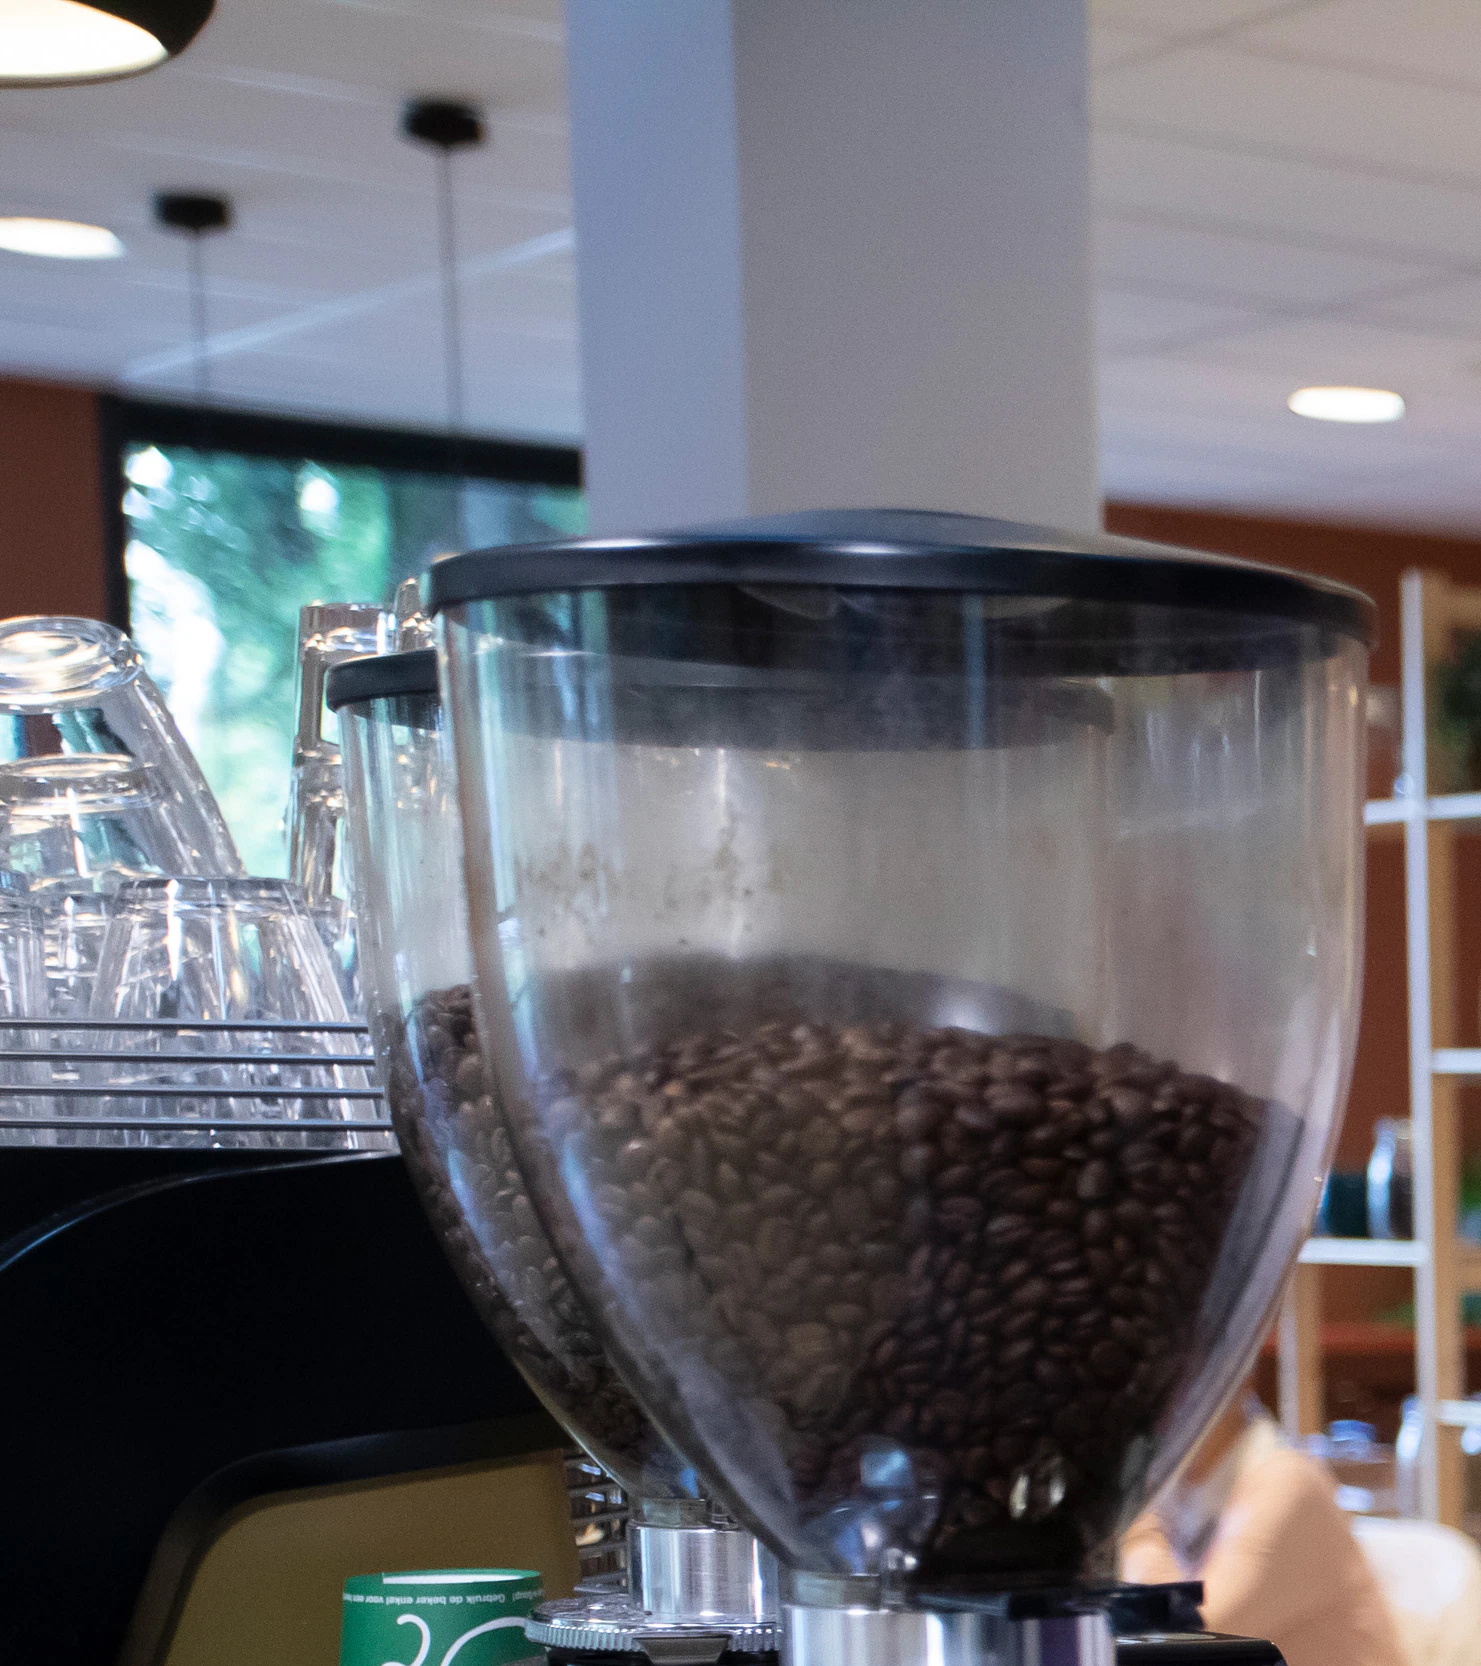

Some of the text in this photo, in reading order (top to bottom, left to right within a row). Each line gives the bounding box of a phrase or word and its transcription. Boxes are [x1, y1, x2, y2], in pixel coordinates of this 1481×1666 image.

[385, 1595, 413, 1606] enkel
[415, 1595, 446, 1606] beker
[449, 1595, 463, 1605] de
[466, 1593, 506, 1604] Gebruik
